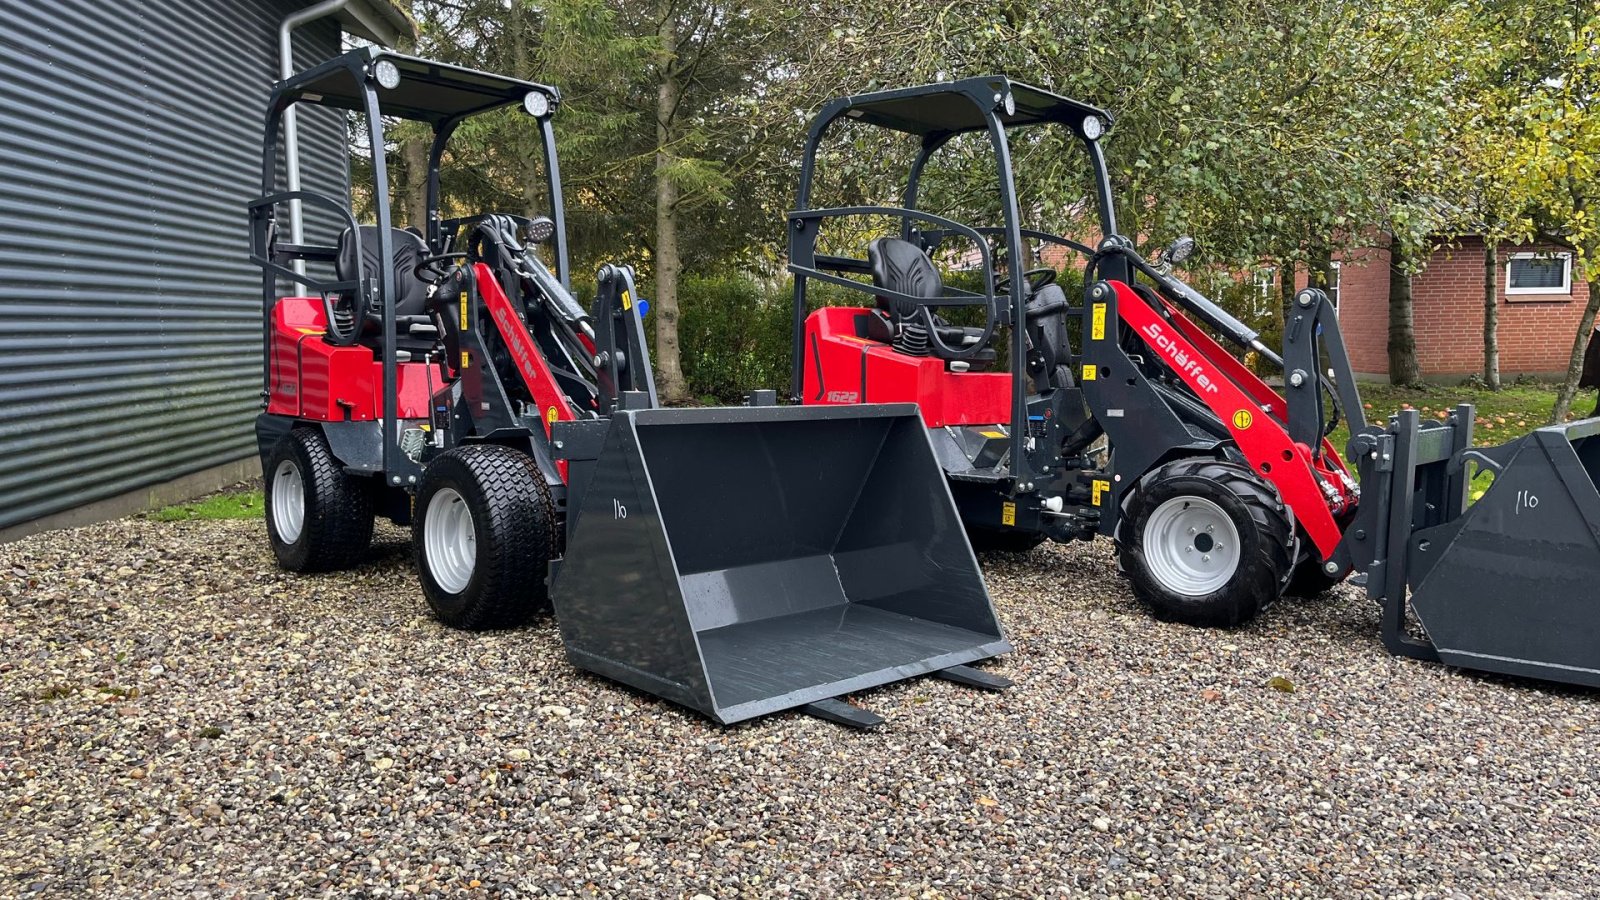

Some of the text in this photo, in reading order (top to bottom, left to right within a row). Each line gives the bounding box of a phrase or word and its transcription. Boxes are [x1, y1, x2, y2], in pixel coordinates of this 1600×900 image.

[495, 307, 537, 379] Schäffer
[1141, 323, 1218, 393] Schäffer
[827, 390, 858, 403] 1622
